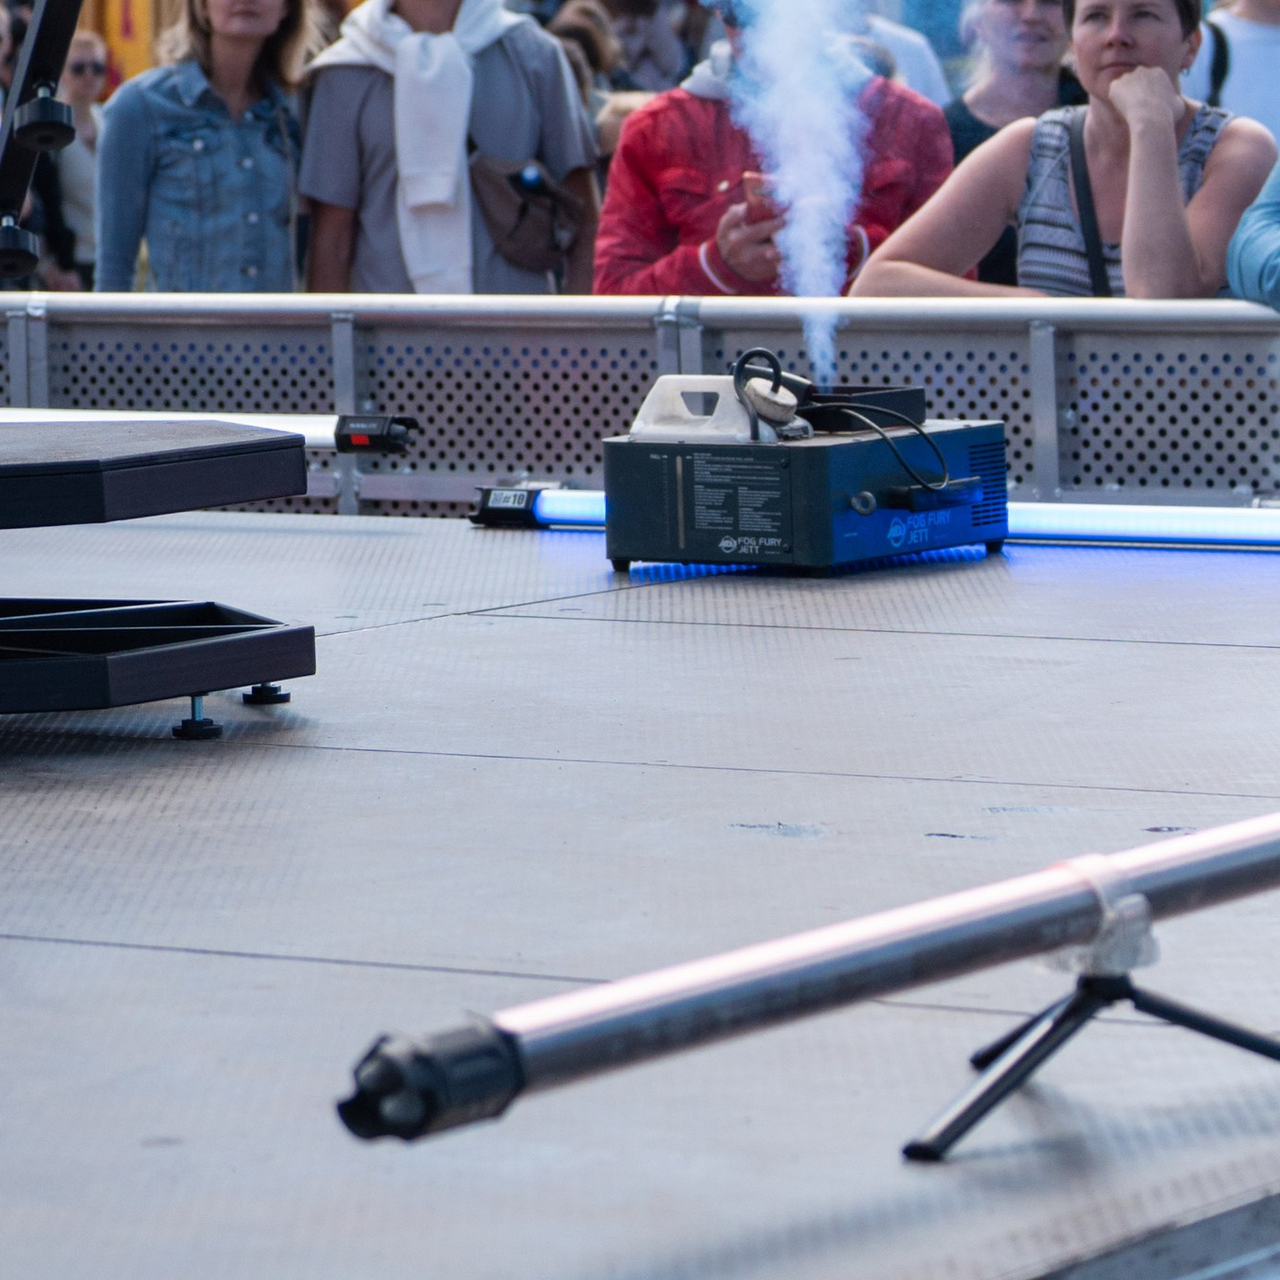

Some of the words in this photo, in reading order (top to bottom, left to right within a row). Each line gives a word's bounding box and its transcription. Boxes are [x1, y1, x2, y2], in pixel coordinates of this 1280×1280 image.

[737, 537, 757, 546] FOG
[758, 537, 782, 547] FURY
[738, 545, 760, 555] JETT
